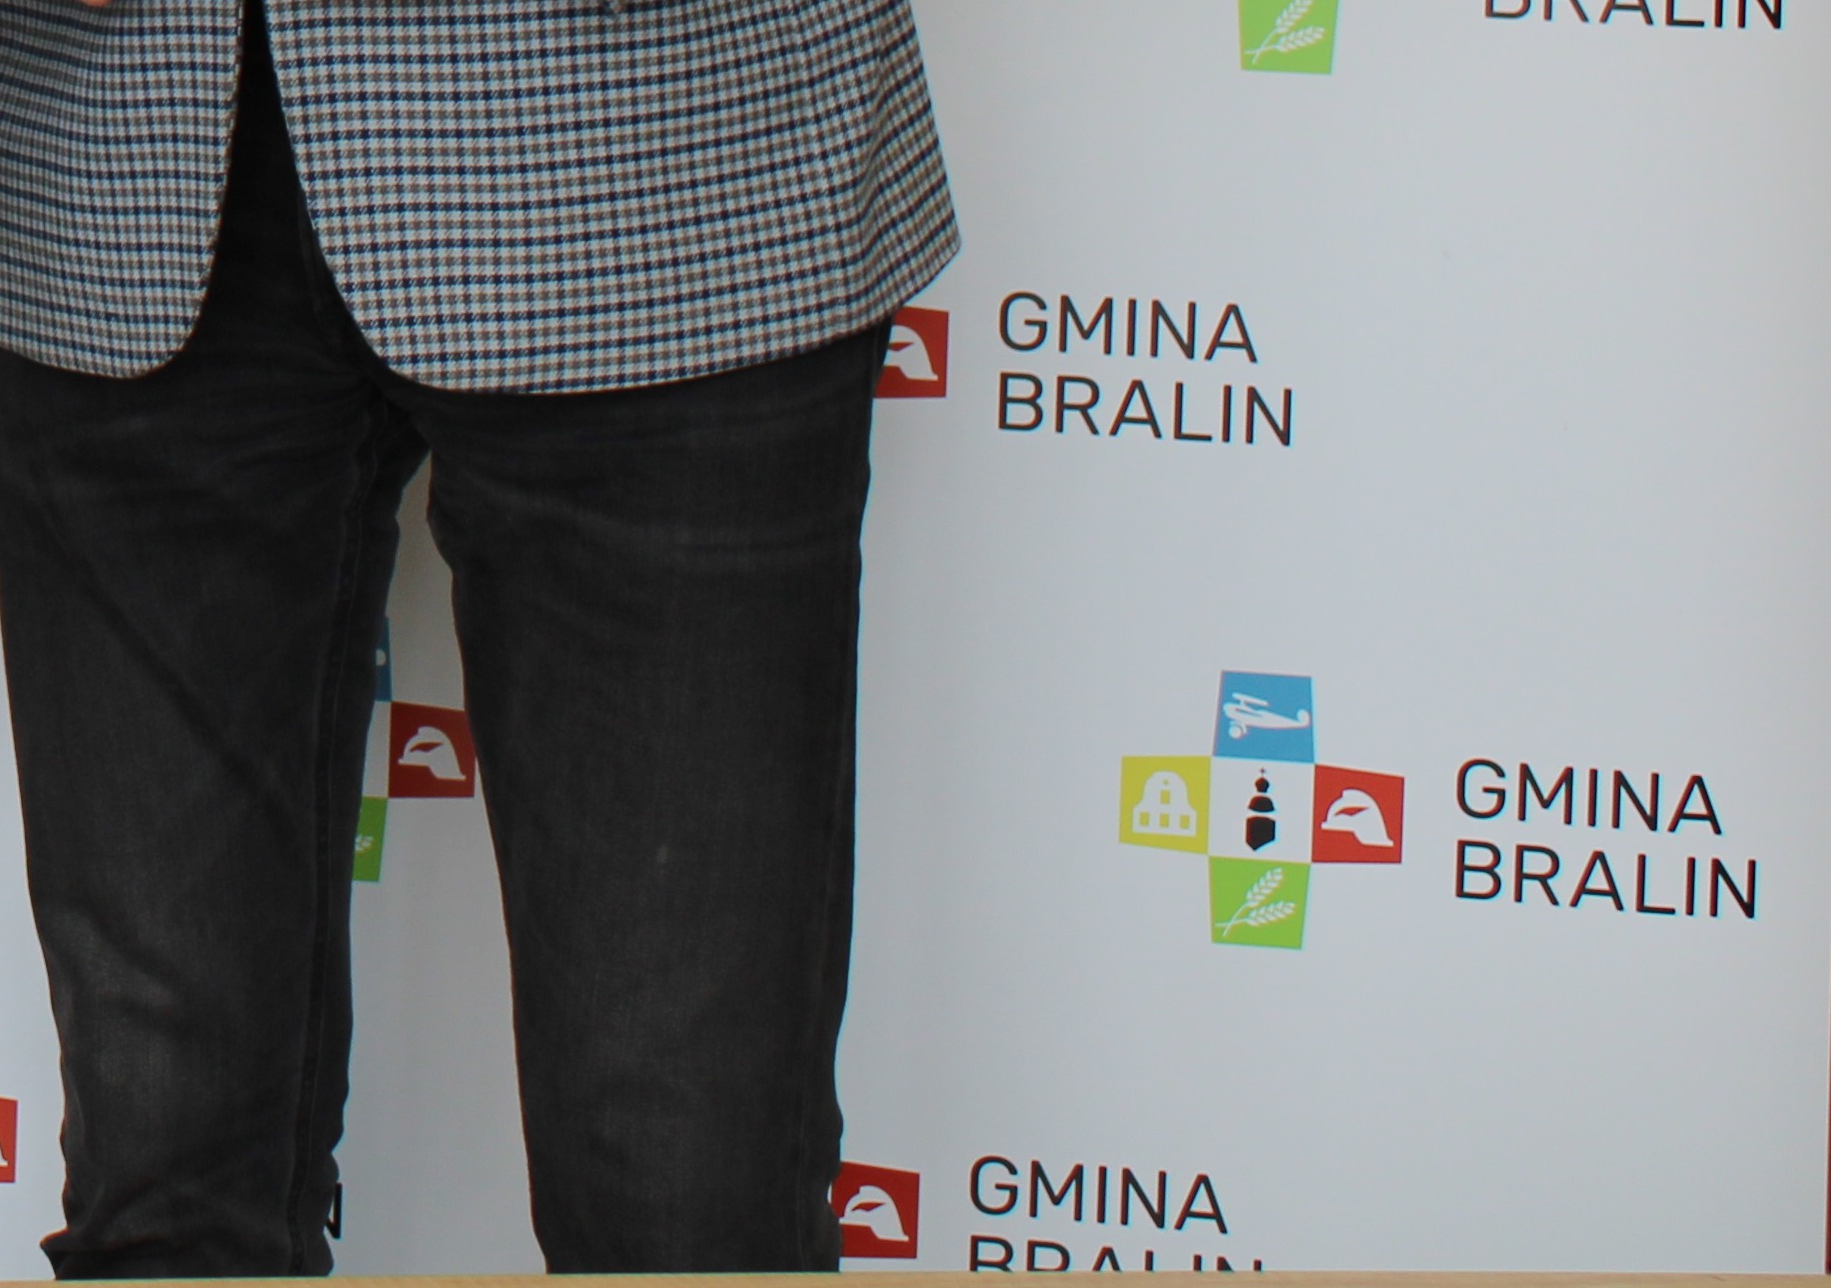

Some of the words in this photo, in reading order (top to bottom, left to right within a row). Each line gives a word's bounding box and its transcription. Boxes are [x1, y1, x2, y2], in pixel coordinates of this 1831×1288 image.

[998, 291, 1259, 365] GMINA
[997, 371, 1293, 448] BRALIN
[1456, 758, 1724, 837] GMINA
[1454, 839, 1758, 920] BRALIN
[969, 1155, 1229, 1235] GMINA
